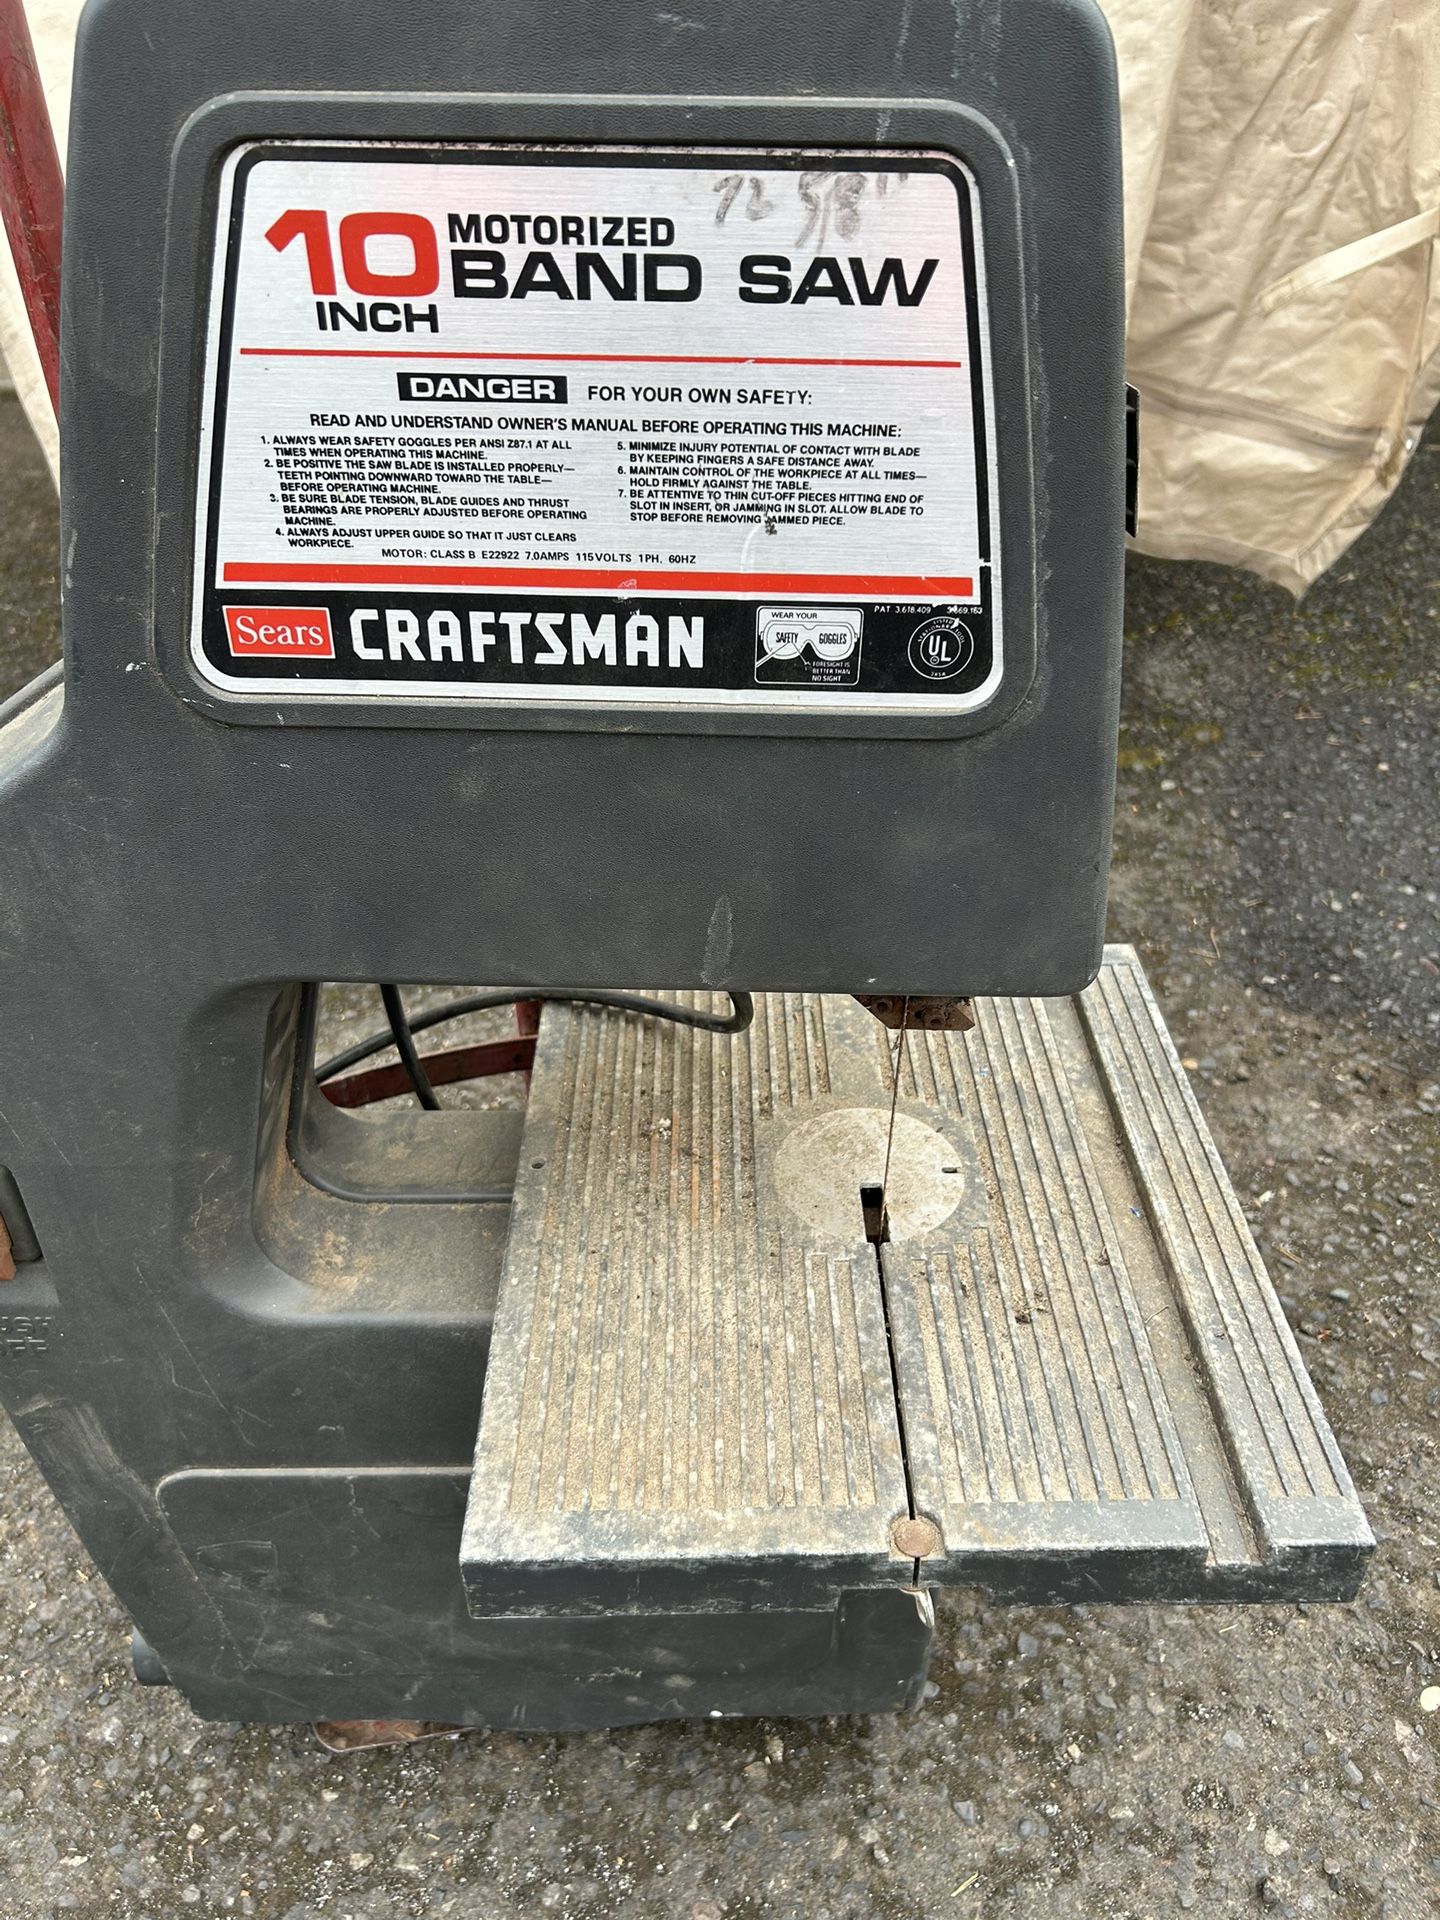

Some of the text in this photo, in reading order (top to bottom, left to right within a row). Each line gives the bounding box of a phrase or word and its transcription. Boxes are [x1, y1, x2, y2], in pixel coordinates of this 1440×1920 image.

[447, 214, 674, 247] MOTORIZED
[263, 208, 440, 297] 10
[450, 249, 939, 307] BAND SAW
[316, 301, 439, 333] INCH
[407, 377, 556, 399] DANGER
[587, 385, 811, 405] FOR YOUR OWN SAFETY:
[309, 413, 901, 437] READ AND UNDERSTAND OWNER'S MANUAL BEFORE OPERATING THIS MACHINE:
[272, 435, 572, 449] ALWAYS WEAR SAFETY GOGGLES PER ANSI Z87.1 AT ALL
[628, 441, 920, 456] MINIMIZE INJURY POTENTIAL OF CONTACT WITH BLADE
[273, 447, 487, 460] TIMES WHEN OPERATING THIS MACHINE.
[629, 453, 874, 467] BY KEEPING FINGERS SAFE DISTANCE AWAY.
[275, 458, 291, 468] BE
[292, 459, 342, 469] POSITIVE
[344, 459, 366, 469] THE
[367, 460, 392, 469] SAW
[394, 460, 432, 470] BLADE
[433, 461, 444, 470] IS
[446, 461, 505, 472] INSTALLED
[629, 465, 679, 475] MAINTAIN
[681, 466, 734, 477] CONTROL
[735, 467, 750, 477] OF
[753, 468, 774, 477] THE
[777, 468, 842, 479] WORKPIECE
[844, 469, 858, 479] AT
[860, 470, 881, 479] ALL
[277, 470, 312, 480] TEETH
[314, 471, 365, 481] POINTING
[367, 472, 433, 482] DOWNWARD
[435, 473, 481, 483] TOWARD
[483, 474, 504, 483] THE
[629, 477, 811, 490] HOLD FIRMLY AGAINST THE TABLE.
[279, 482, 441, 493] BEFORE OPERATING MACHINE.
[280, 493, 569, 508] BE SURE BLADE TENSION, BLADE GUIDES AND THRUST
[629, 488, 924, 504] BE ATTENTIVE TO THIN CUT-OFF PIECES HITTING END OF
[282, 504, 587, 520] BEARINGS ARE PROPERLY ADJUSTED BEFORE OPERATING
[629, 500, 923, 515] SLOT IN INSERT, OR JAMMING IN SLOT. ALLOW BLADE TO
[284, 516, 335, 526] MACHINE.
[629, 512, 658, 522] STOP
[660, 512, 703, 522] BEFORE
[705, 513, 761, 524] REMOVING
[811, 516, 845, 525] PIECE.
[286, 527, 576, 542] ALWAYS ADJUST UPPER GUIDE SO THAT JUST CLEARS
[287, 538, 354, 548] WORKPIECE.
[381, 548, 426, 558] MOTOR:
[429, 549, 465, 559] CLASS
[468, 550, 476, 559] B
[481, 550, 519, 560] E22922
[668, 554, 696, 564] 60HZ
[874, 605, 891, 613] PAT
[235, 615, 324, 647] Sears
[349, 608, 704, 669] CRAFTSMAN
[776, 631, 847, 645] SAFETY GOGGLES
[928, 635, 951, 662] UL
